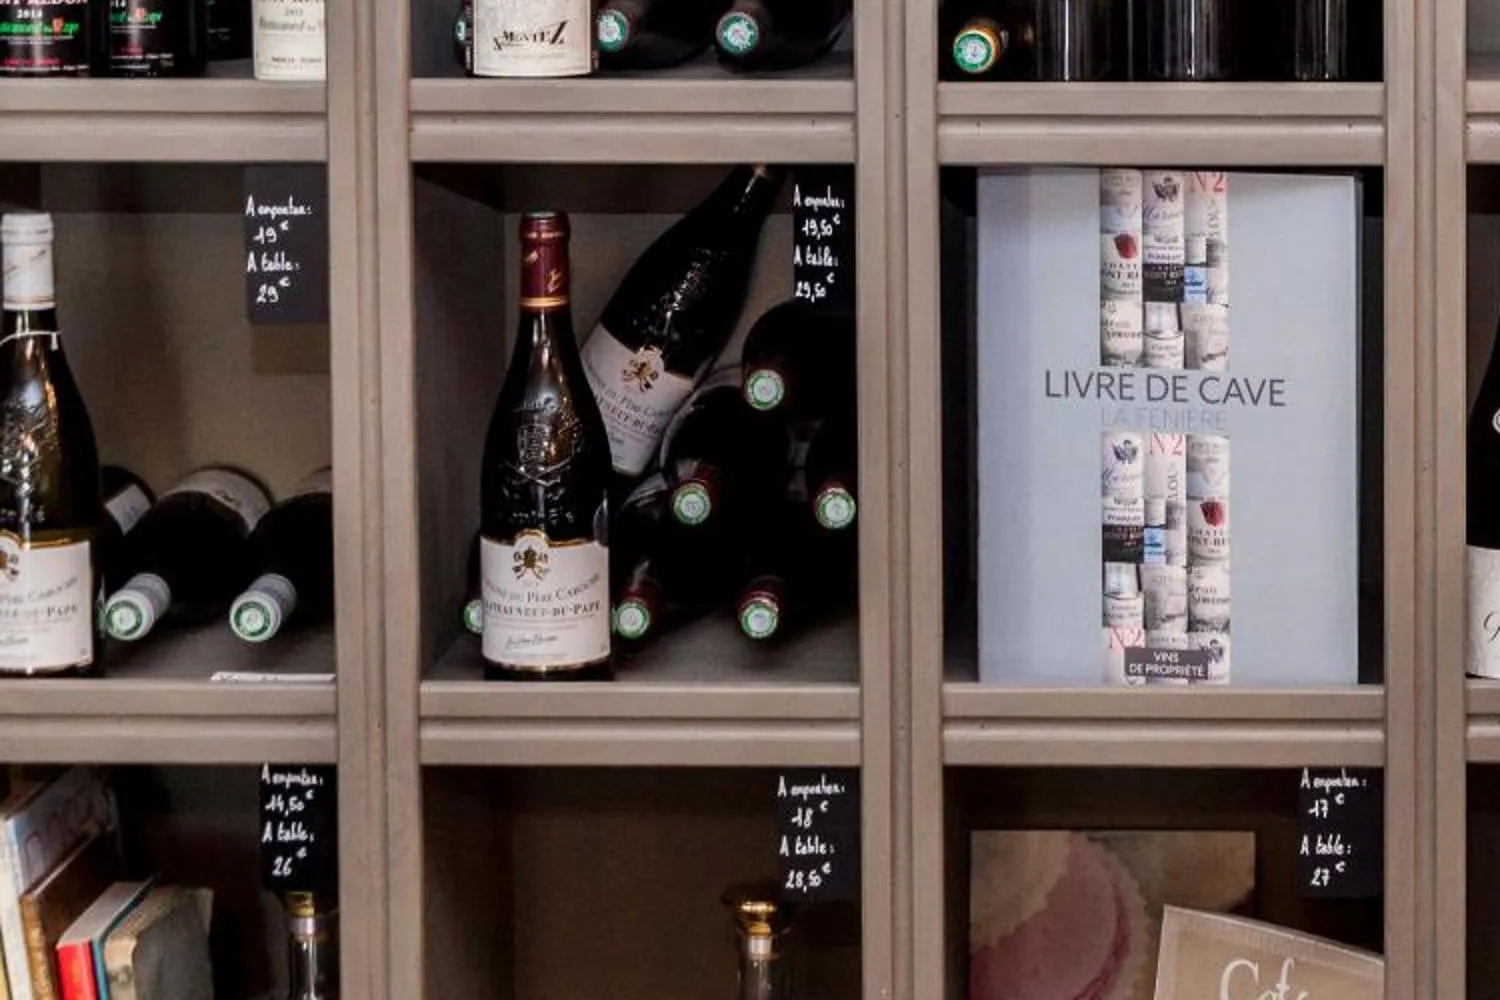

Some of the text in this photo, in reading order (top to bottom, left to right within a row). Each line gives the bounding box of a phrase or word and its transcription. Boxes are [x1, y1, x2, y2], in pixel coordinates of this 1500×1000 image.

[245, 195, 255, 217] A
[793, 184, 801, 207] A
[247, 250, 257, 272] A
[793, 244, 802, 266] A
[1045, 370, 1287, 407] LIVRE DE CAVE
[1129, 663, 1144, 673] DE
[1153, 651, 1180, 663] VINS
[261, 761, 270, 784] A
[1301, 767, 1310, 789] A
[778, 775, 787, 797] A
[262, 820, 272, 842] A
[780, 834, 789, 857] A
[1300, 834, 1309, 856] A
